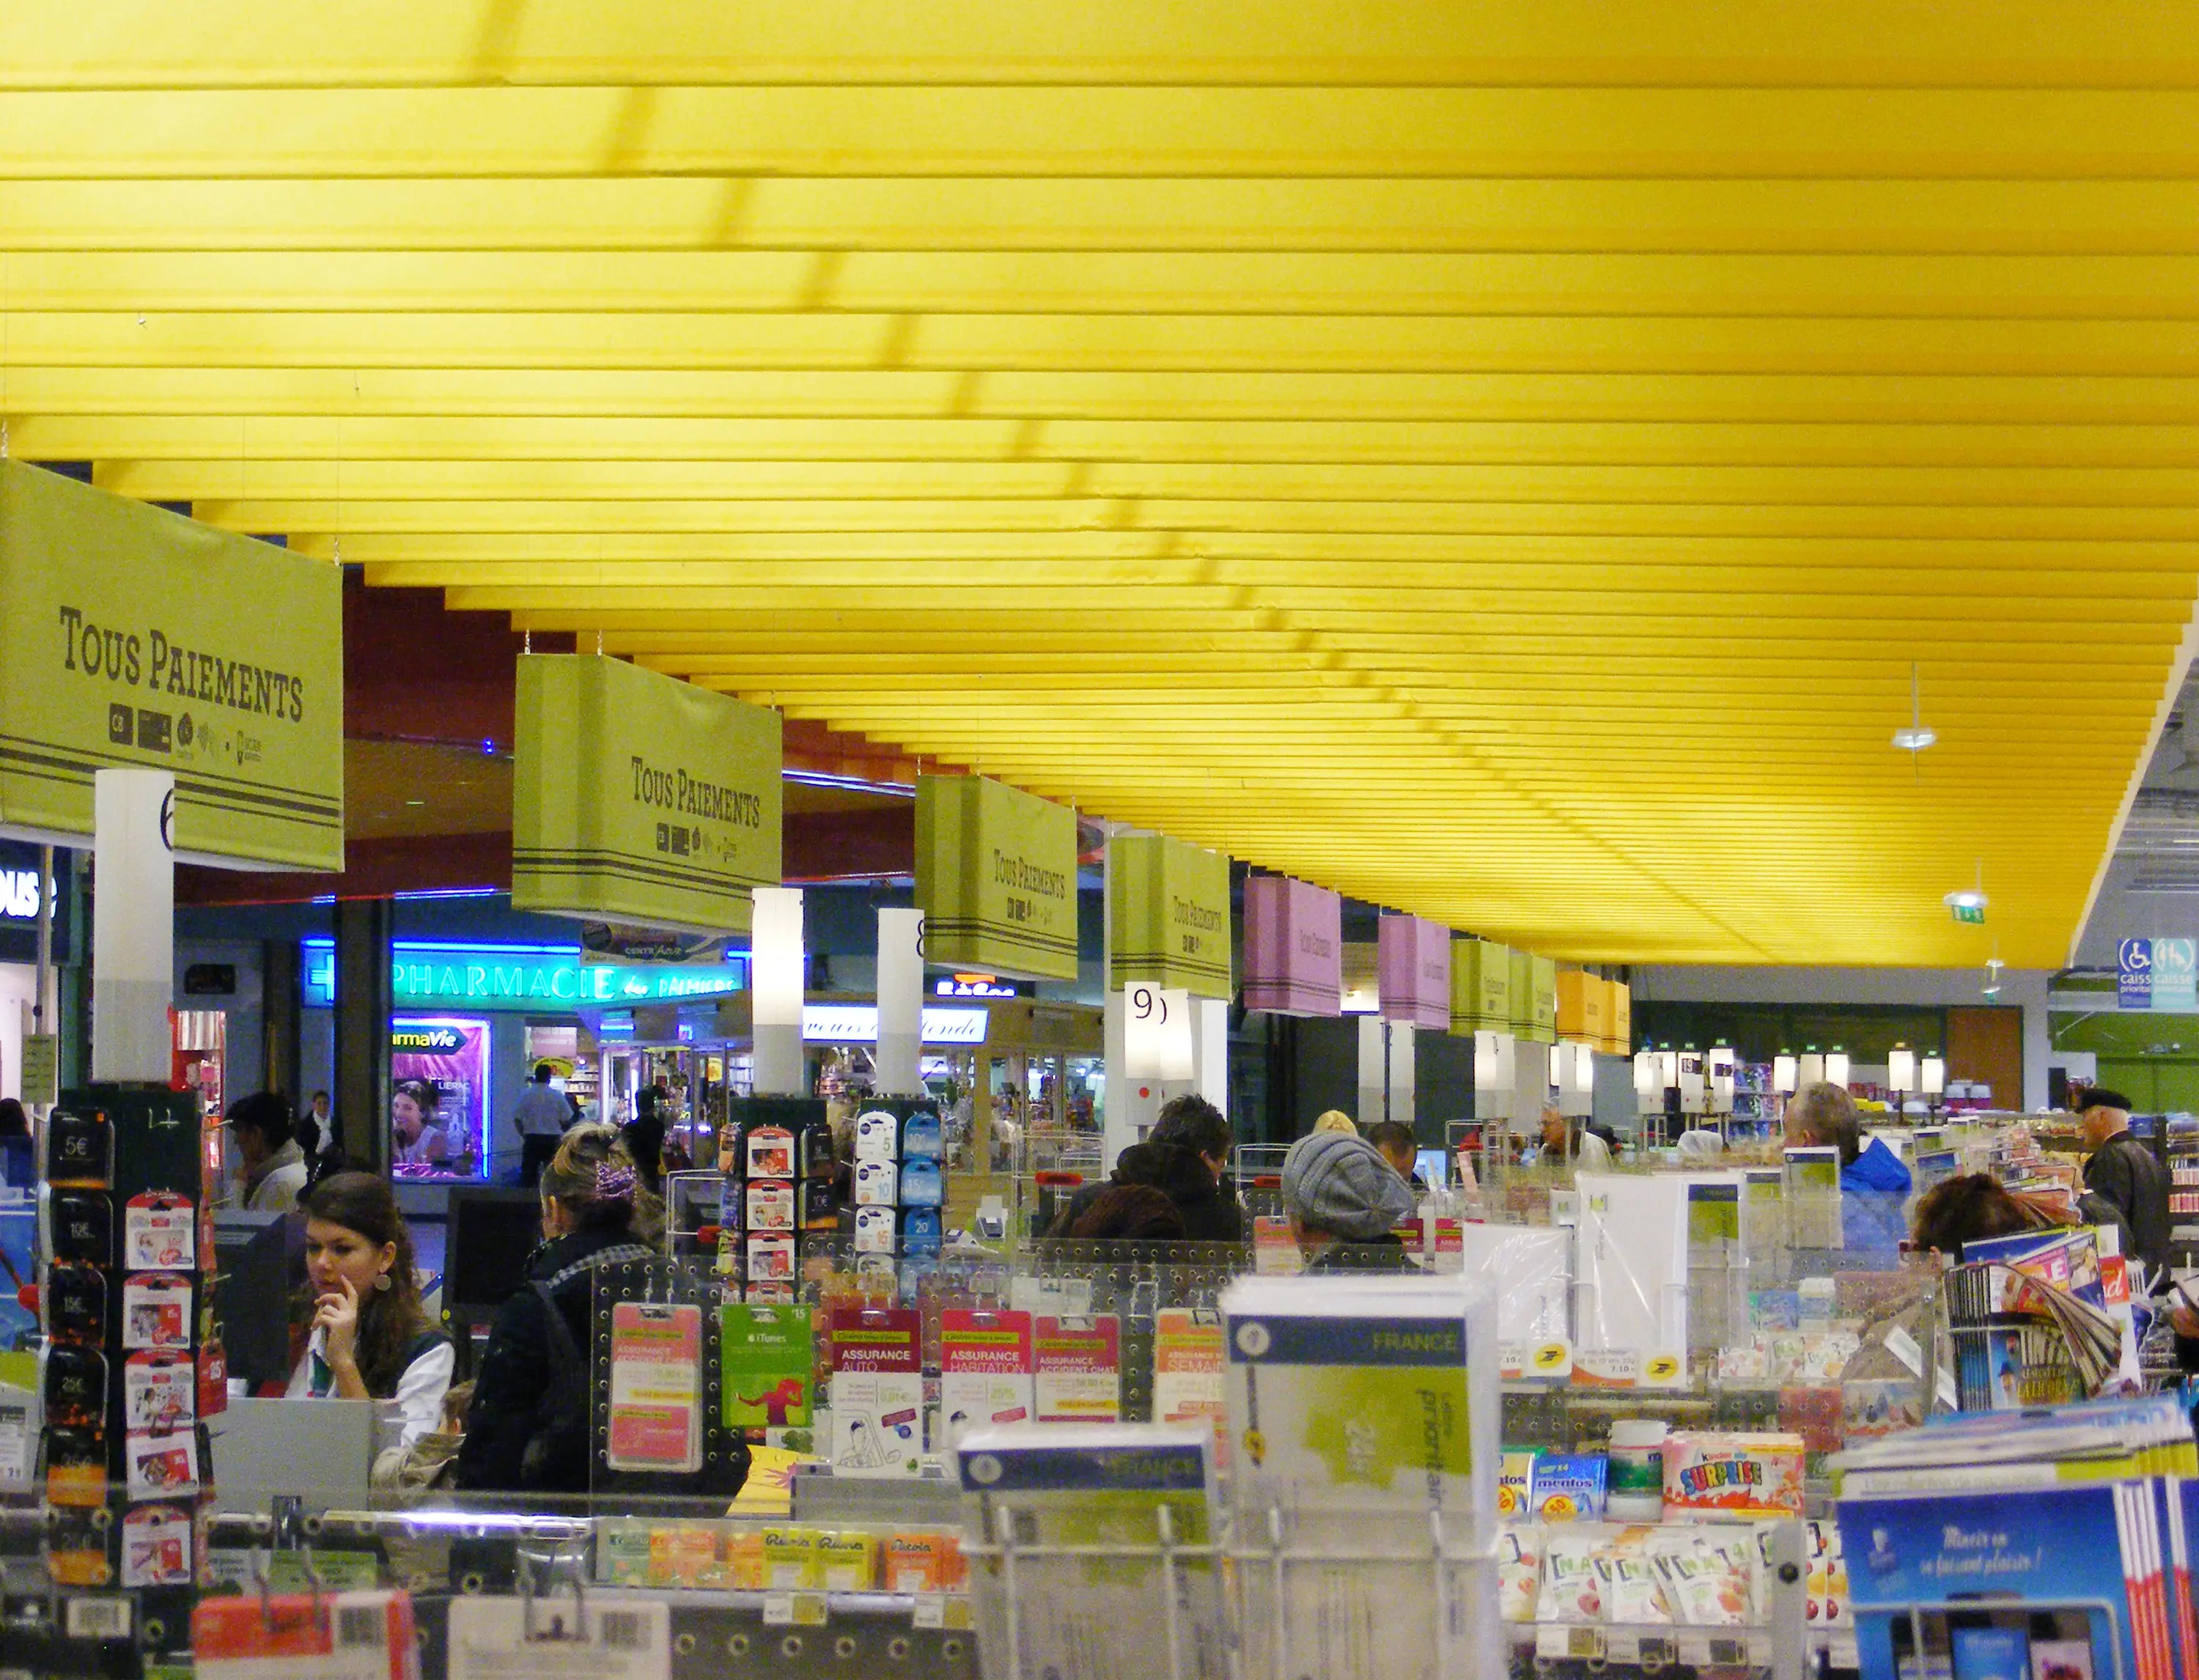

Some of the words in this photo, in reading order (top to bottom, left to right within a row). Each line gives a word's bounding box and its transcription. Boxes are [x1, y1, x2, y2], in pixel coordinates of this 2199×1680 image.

[149, 628, 303, 723] PAIEMENTS
[677, 767, 760, 829] PAIEMENTS
[393, 964, 616, 1000] PHARMACIE
[2121, 973, 2151, 985] caiss
[1372, 1330, 1458, 1351] FRANCE
[842, 1349, 911, 1361] ASSURANCE
[950, 1350, 1020, 1362] ASSURANCE
[1039, 1356, 1094, 1366] ASSURANCE
[842, 1361, 878, 1373] AUTO
[950, 1362, 1025, 1374] HABITATION
[1537, 1478, 1593, 1489] mentos
[1680, 1460, 1762, 1496] SURPRISE
